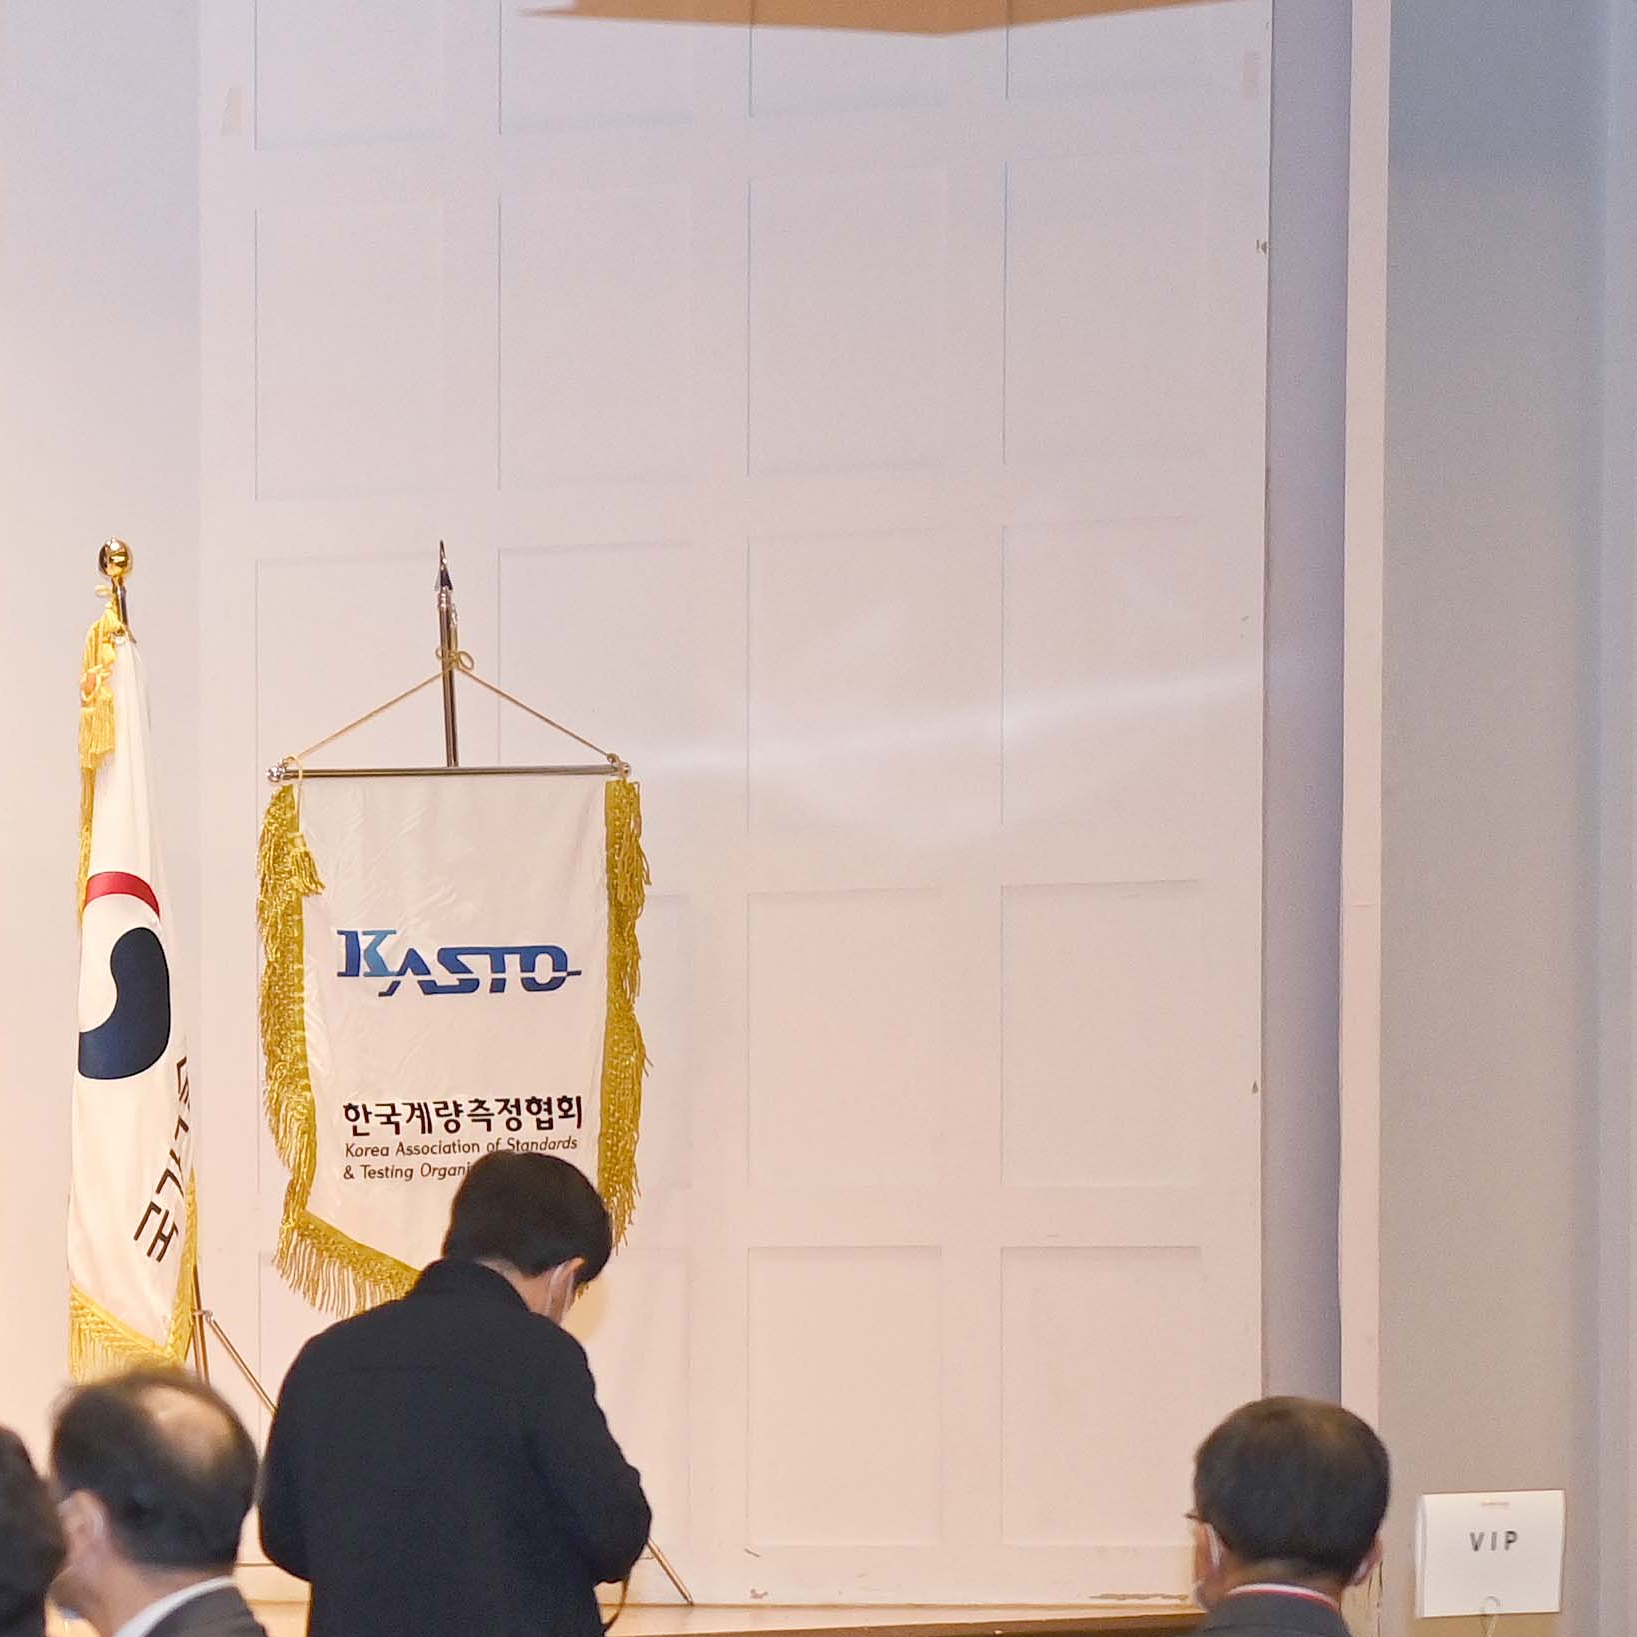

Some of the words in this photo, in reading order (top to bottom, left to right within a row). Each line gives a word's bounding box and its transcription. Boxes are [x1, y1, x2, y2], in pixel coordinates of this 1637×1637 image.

[336, 929, 583, 998] KASTO
[342, 1095, 583, 1137] 한국계량측정협회
[344, 1142, 390, 1158] Korea
[395, 1139, 481, 1157] Association
[486, 1137, 503, 1153] of
[506, 1136, 578, 1151] Standards
[343, 1166, 355, 1180] &
[360, 1164, 414, 1182] Testing
[420, 1162, 472, 1178] Organi
[1470, 1530, 1520, 1552] VIP
